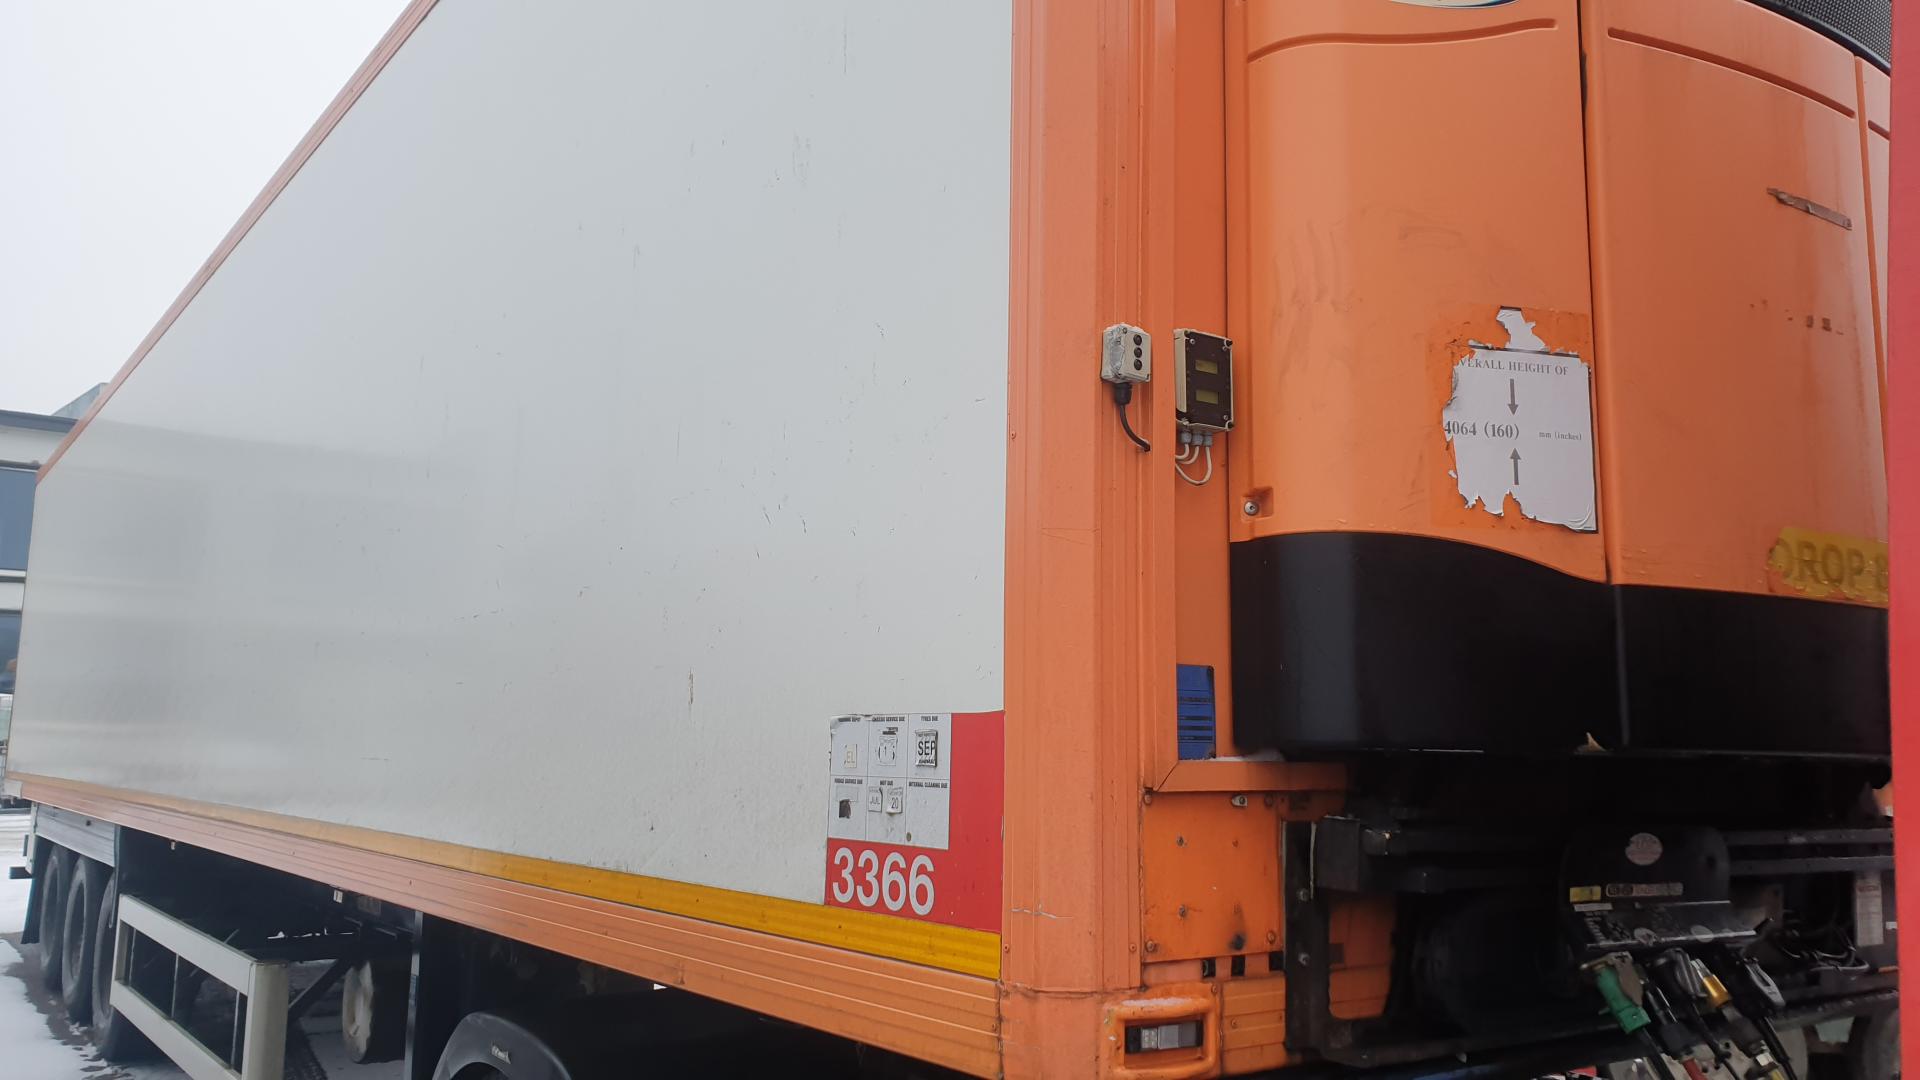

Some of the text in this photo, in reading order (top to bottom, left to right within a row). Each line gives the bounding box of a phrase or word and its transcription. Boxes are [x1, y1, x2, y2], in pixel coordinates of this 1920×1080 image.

[1459, 358, 1569, 376] VERALL HEIGHT OF
[1444, 420, 1582, 441] 4064 (160) mm (inches)
[917, 740, 936, 756] SEP
[832, 847, 935, 916] 3366
